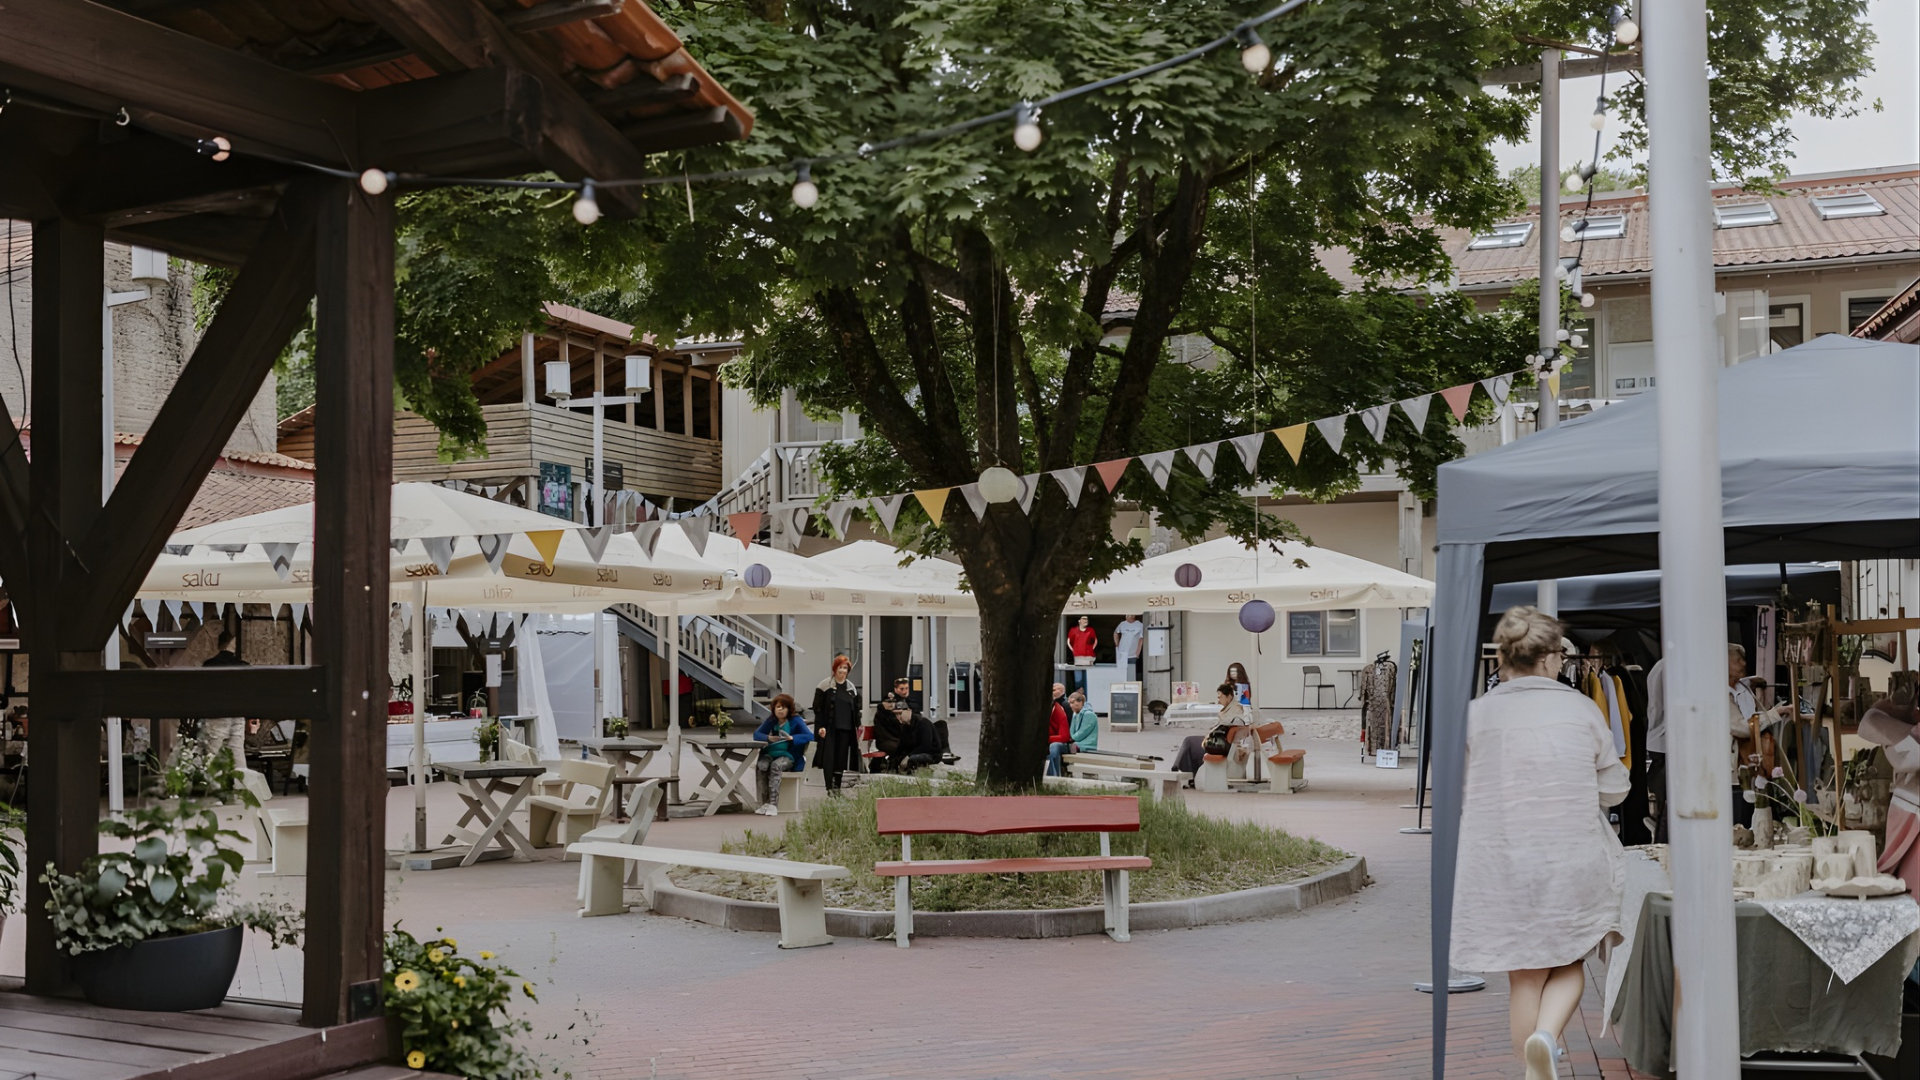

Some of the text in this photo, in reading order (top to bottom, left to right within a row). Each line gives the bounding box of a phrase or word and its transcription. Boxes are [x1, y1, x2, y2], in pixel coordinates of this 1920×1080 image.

[182, 569, 221, 587] saku
[291, 569, 313, 584] sa
[1147, 594, 1176, 607] saku
